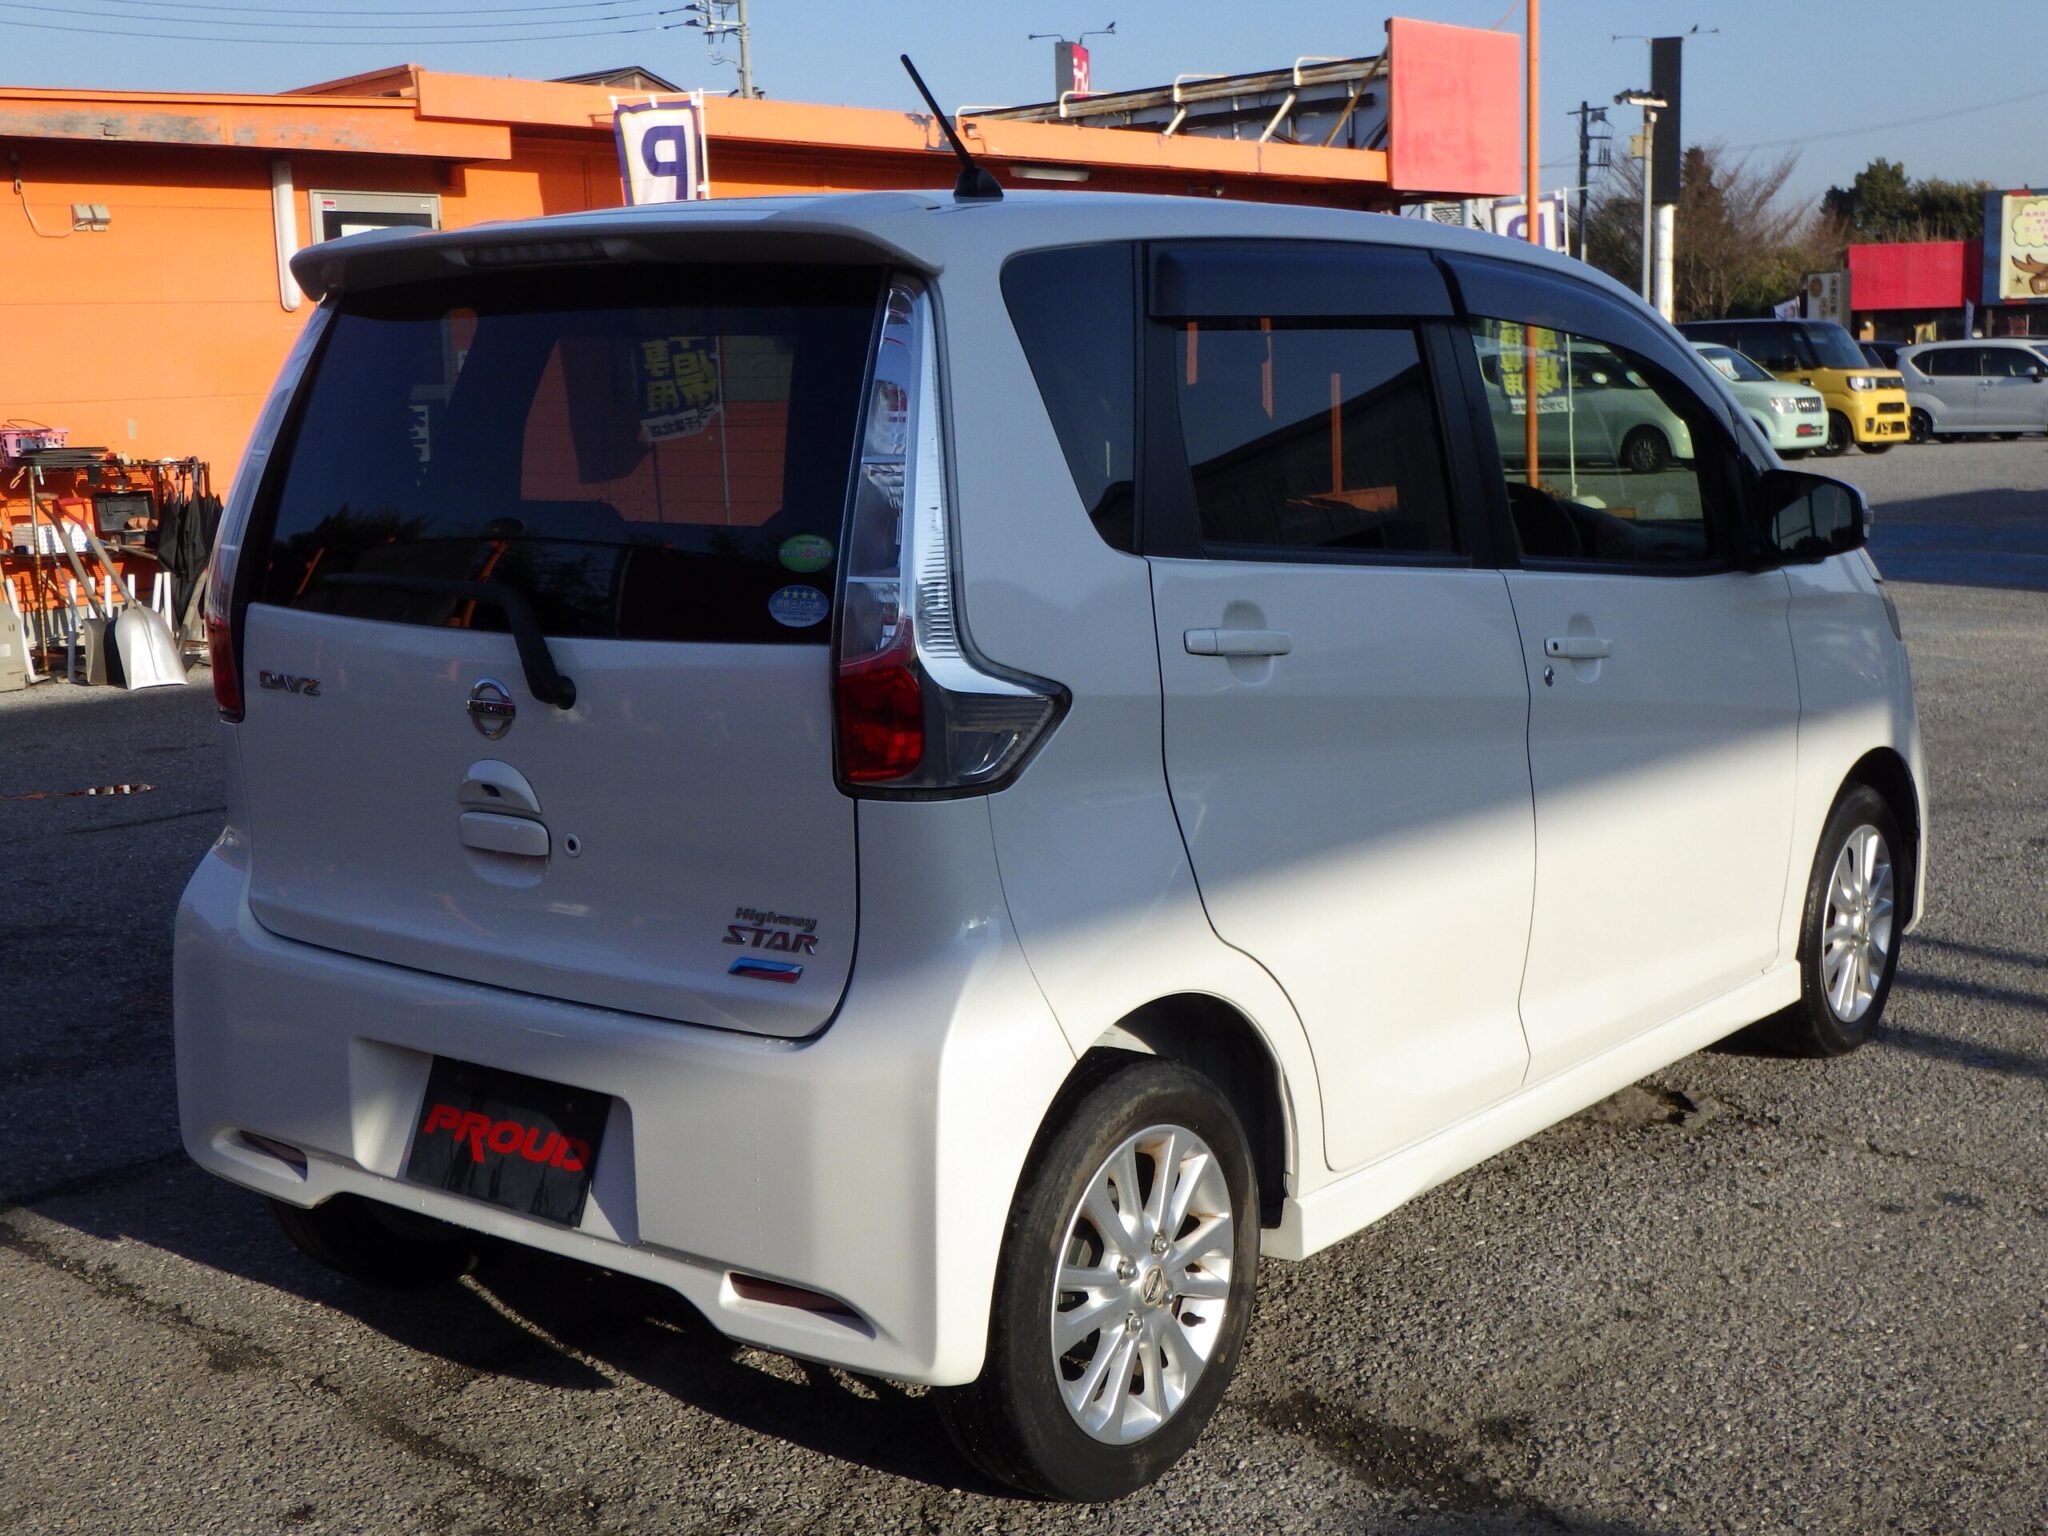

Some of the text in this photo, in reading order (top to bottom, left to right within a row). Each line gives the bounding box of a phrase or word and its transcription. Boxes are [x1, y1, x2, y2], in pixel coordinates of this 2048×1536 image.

[259, 670, 321, 697] DAYZ
[735, 907, 818, 933] Highway
[722, 924, 818, 955] STAR
[423, 1103, 591, 1172] PROUD
